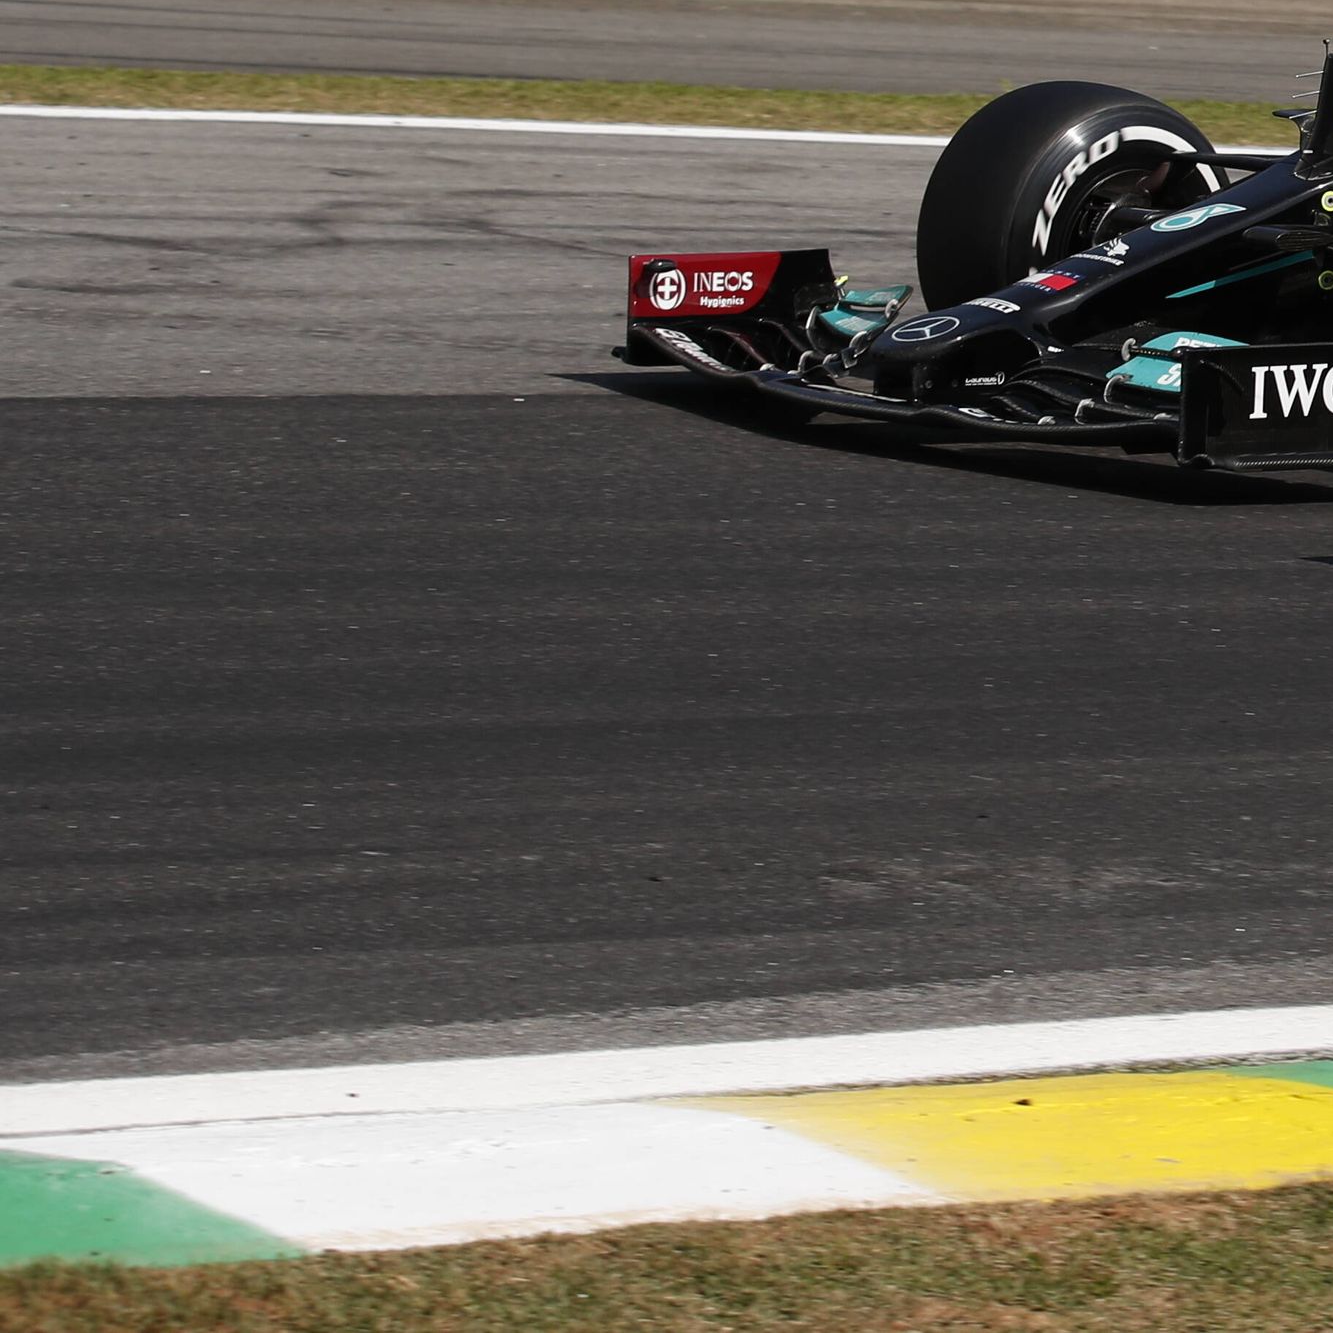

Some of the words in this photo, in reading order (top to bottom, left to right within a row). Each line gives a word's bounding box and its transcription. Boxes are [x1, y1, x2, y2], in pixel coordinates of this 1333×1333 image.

[1032, 130, 1121, 257] ZERO
[693, 271, 753, 293] INEOS
[700, 295, 744, 308] Hygienics
